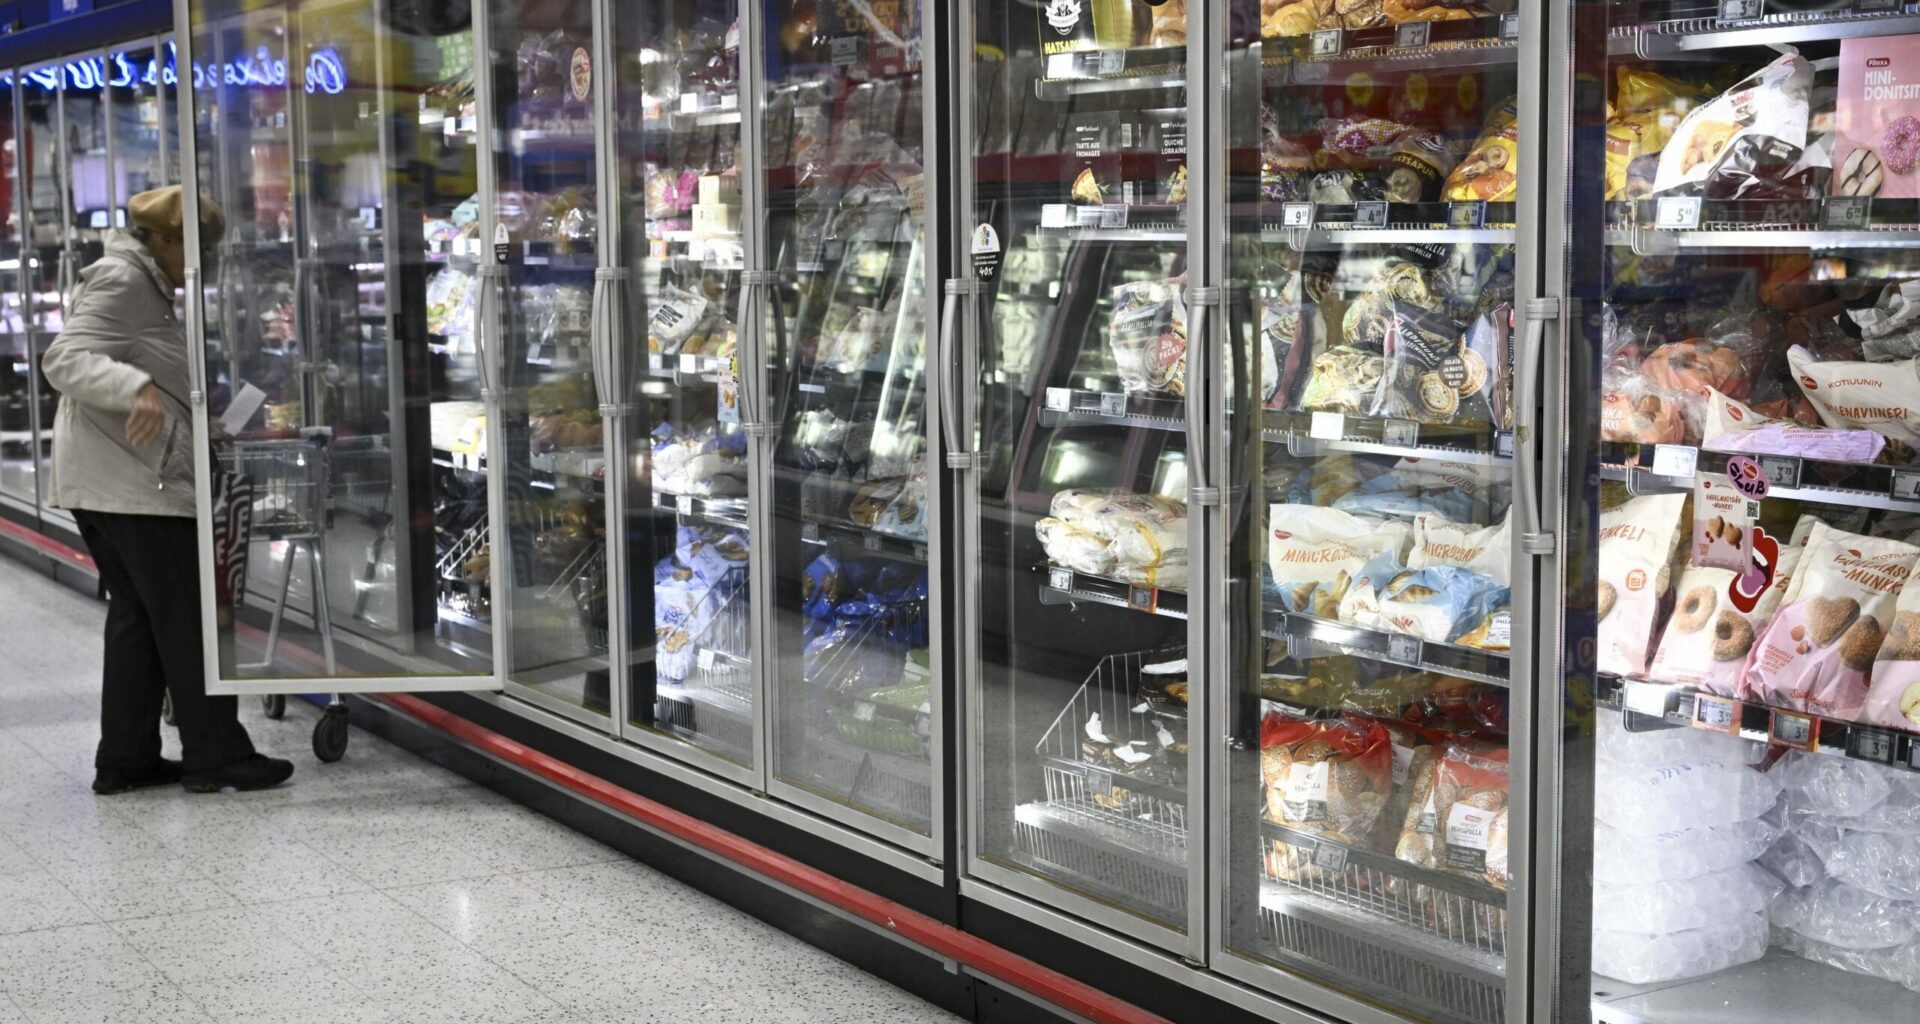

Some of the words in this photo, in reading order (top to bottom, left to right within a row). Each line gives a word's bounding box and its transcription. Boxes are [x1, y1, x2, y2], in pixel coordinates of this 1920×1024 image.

[1865, 71, 1896, 85] MINI-
[1864, 84, 1920, 100] DONITSIT
[1161, 147, 1187, 155] LORRAINE
[1827, 378, 1883, 389] KOTIUUNIN
